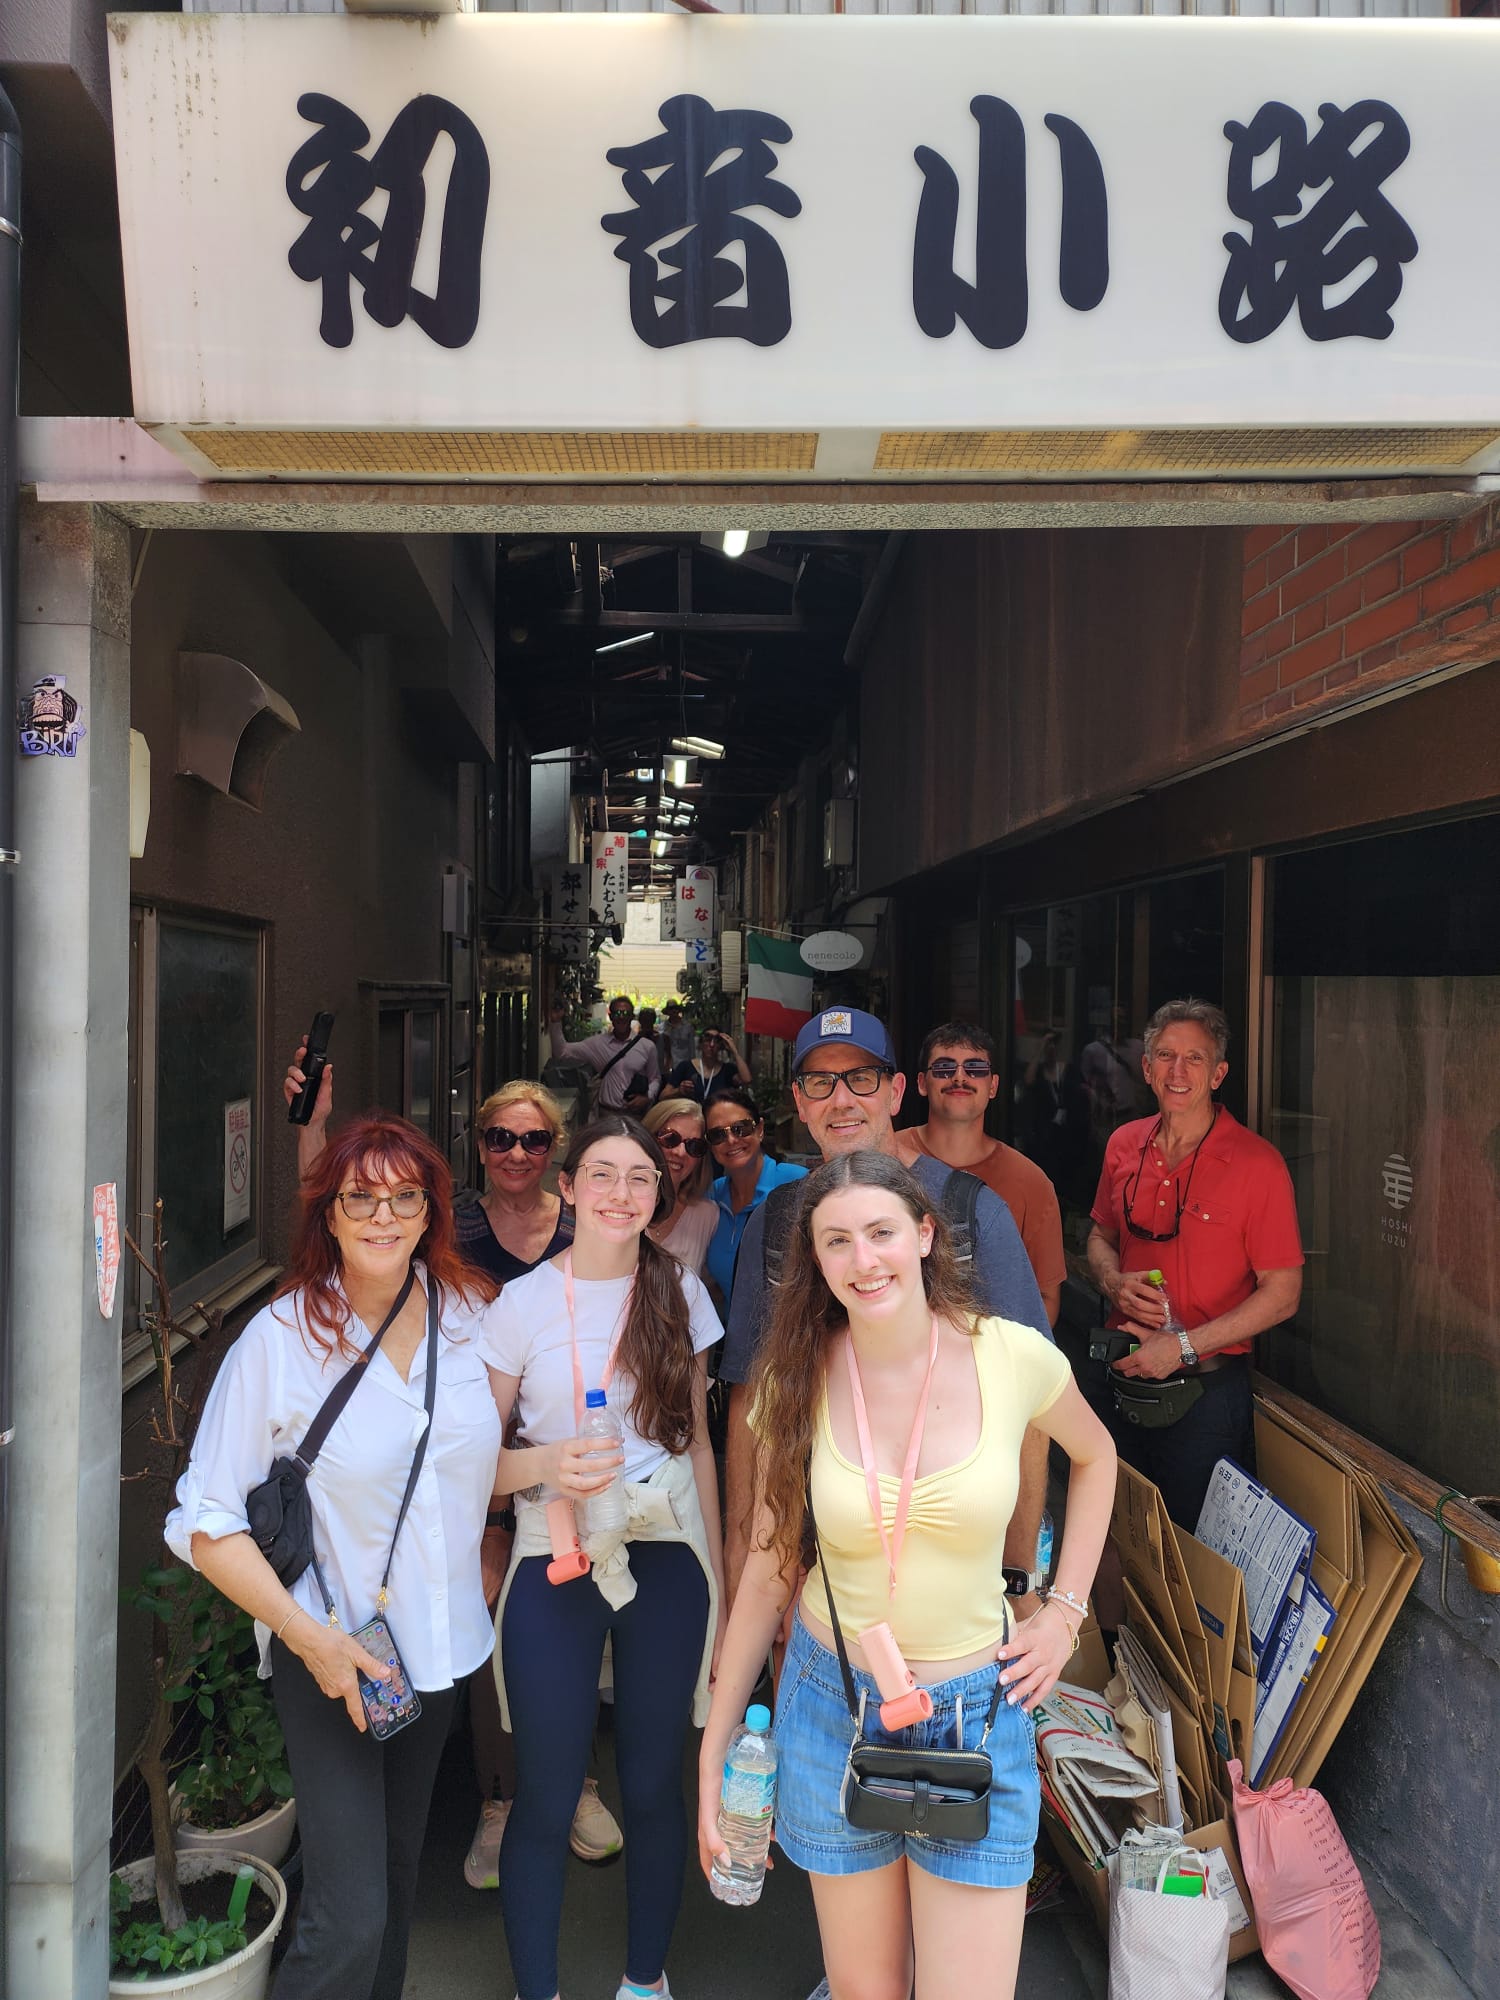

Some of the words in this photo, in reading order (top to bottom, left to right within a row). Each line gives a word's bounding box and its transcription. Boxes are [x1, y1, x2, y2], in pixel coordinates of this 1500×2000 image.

[681, 886, 709, 921] はな
[807, 951, 857, 960] nenecolo
[1381, 1216, 1413, 1234] HOSHI
[1381, 1233, 1406, 1248] KUZU
